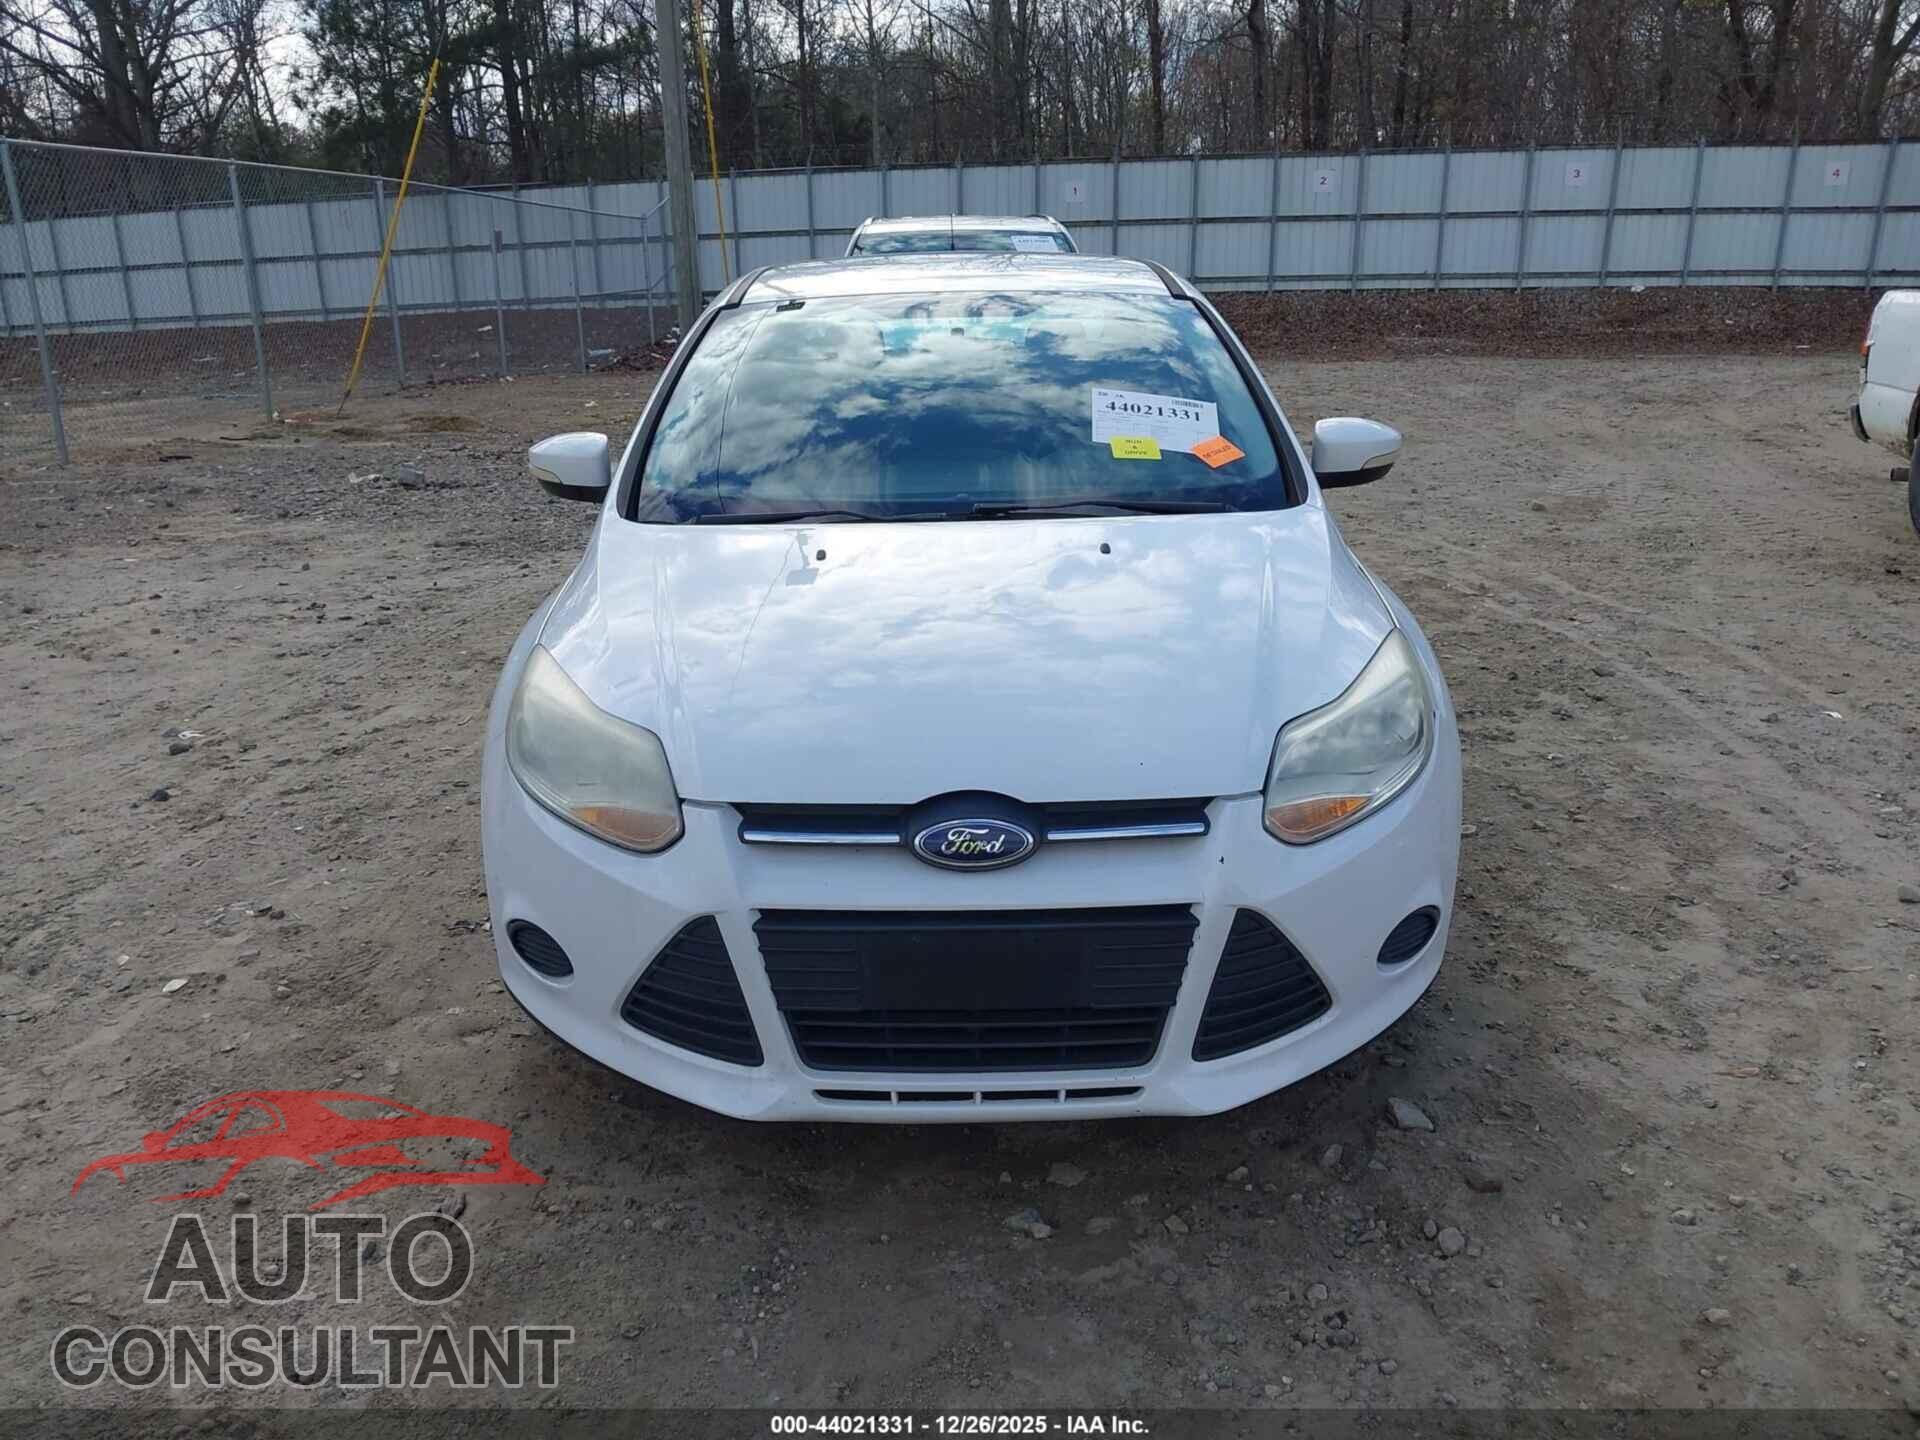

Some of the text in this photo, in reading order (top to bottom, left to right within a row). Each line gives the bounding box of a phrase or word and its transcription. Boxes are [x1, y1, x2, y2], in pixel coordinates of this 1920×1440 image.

[1319, 176, 1328, 185] 2
[1573, 169, 1581, 178] 3
[1105, 401, 1200, 422] 44021331
[940, 827, 1006, 854] Ford
